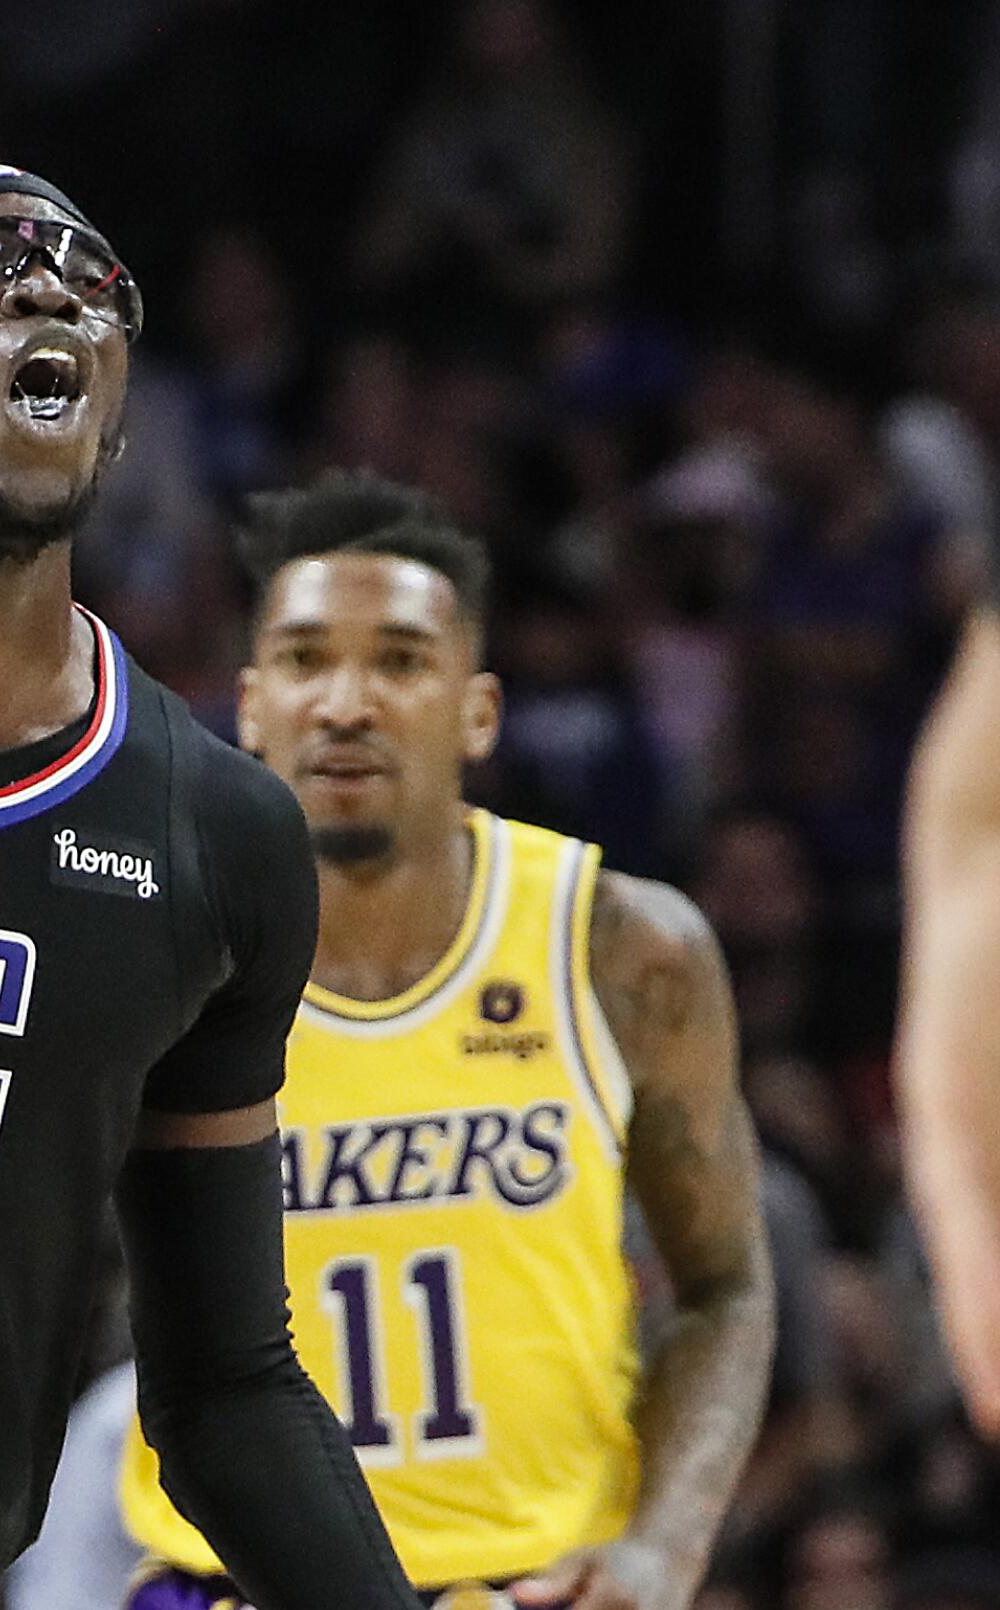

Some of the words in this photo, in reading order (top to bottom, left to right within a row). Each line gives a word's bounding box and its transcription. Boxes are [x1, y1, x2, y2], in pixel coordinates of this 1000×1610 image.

[53, 828, 160, 899] honey
[283, 1103, 570, 1211] AKERS
[324, 1250, 480, 1456] 11
